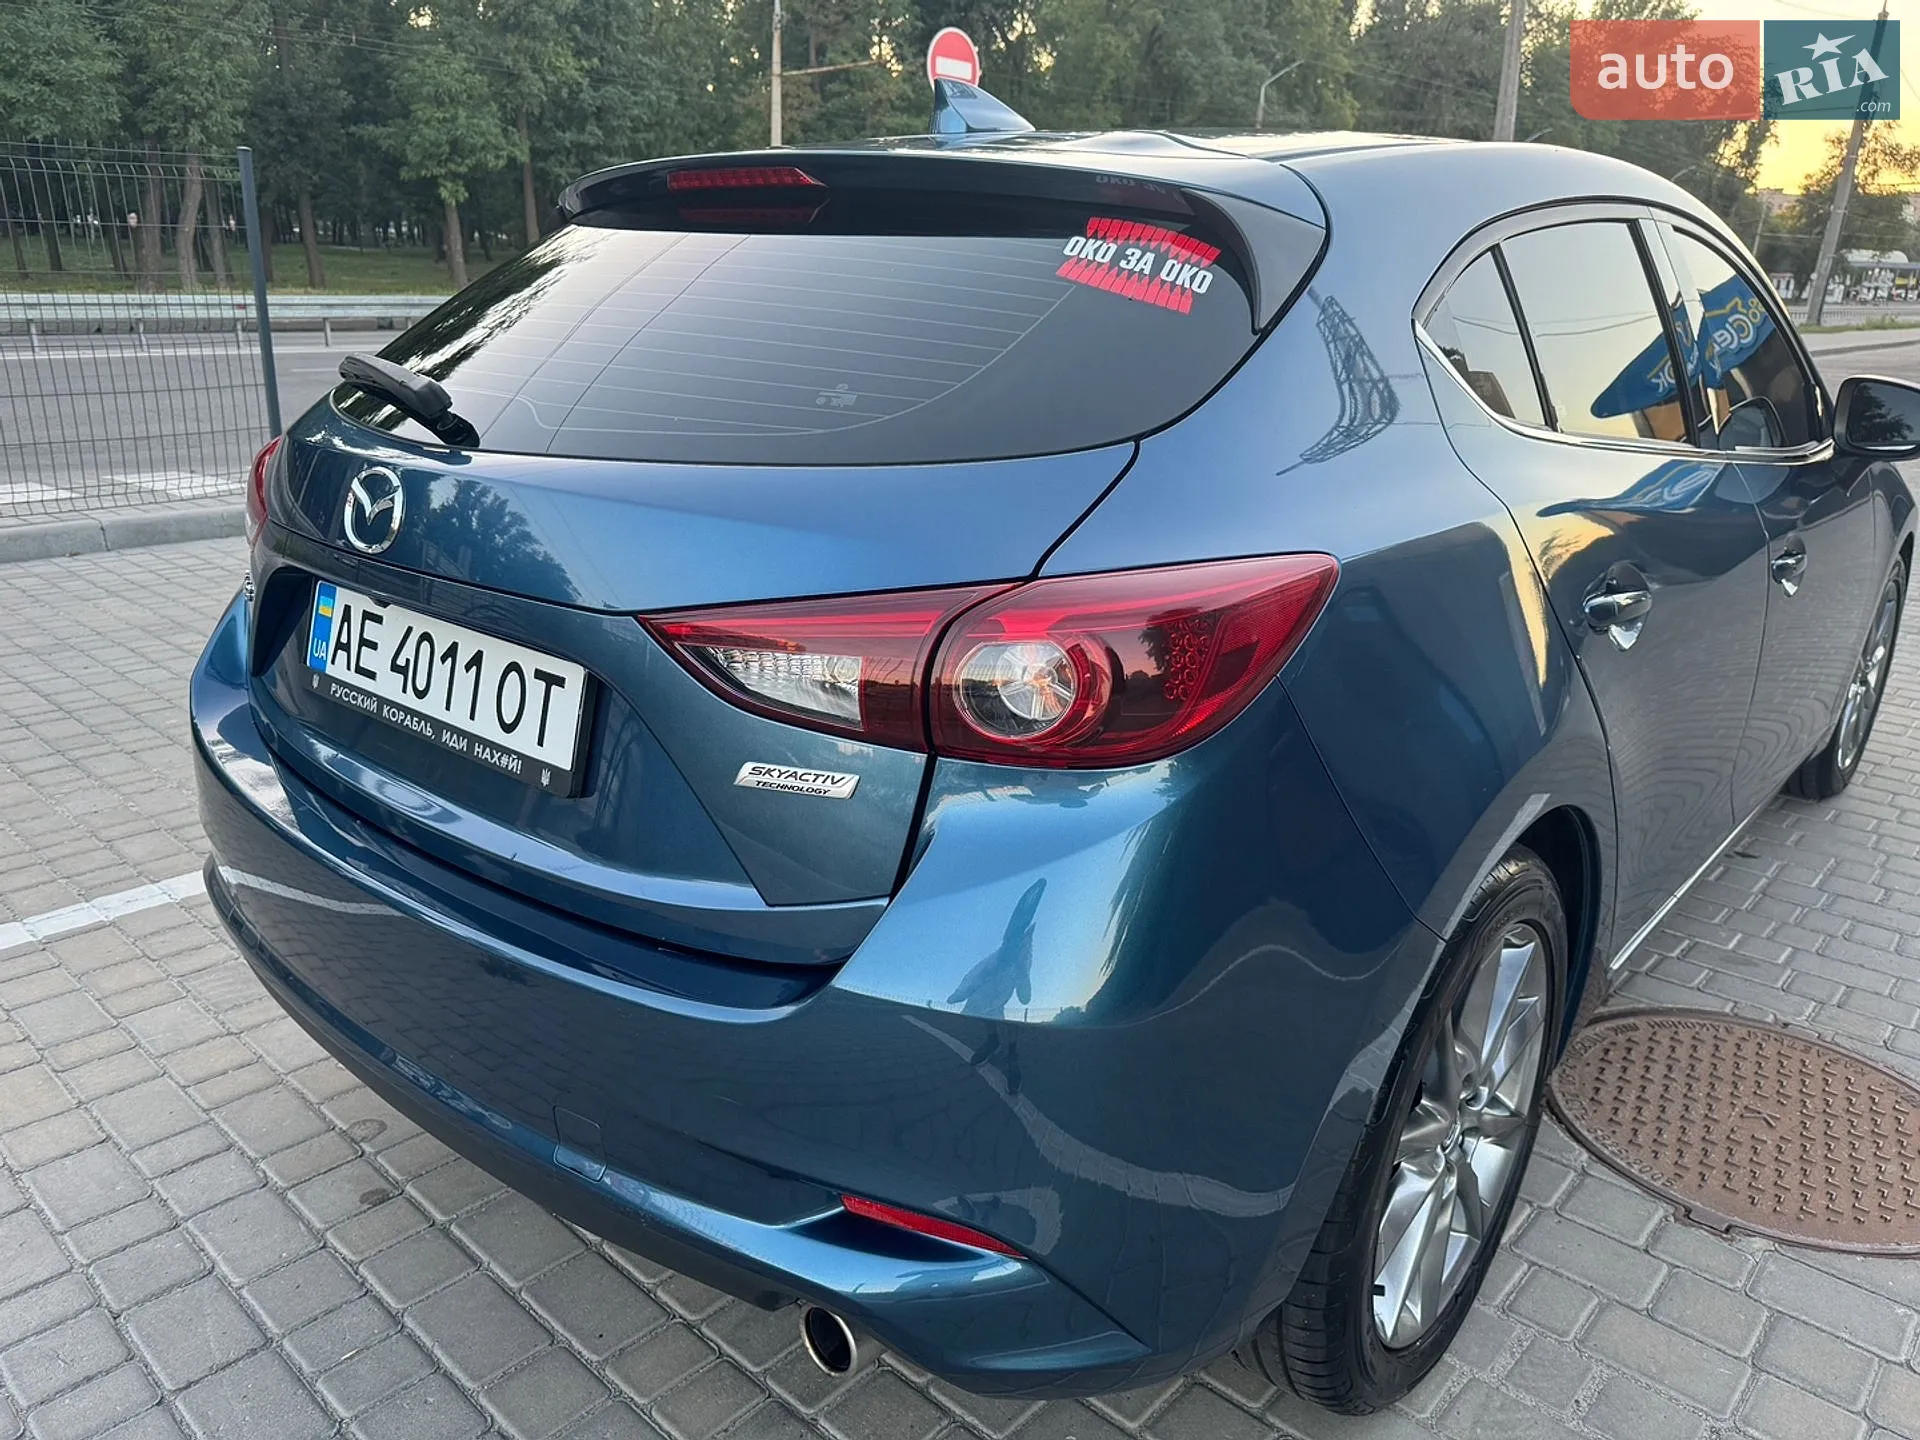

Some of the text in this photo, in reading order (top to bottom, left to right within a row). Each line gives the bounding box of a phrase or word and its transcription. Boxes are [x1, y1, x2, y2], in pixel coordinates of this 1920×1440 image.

[1062, 235, 1214, 294] ОКО ЗА ОКО
[313, 637, 327, 660] UA
[331, 603, 566, 748] AE 4011 OT
[330, 682, 523, 775] РУССКИЙ КОРАБЛЬ, ИДИ НАХ#Й!
[748, 766, 846, 785] SKYACTIV
[755, 780, 831, 795] TECHNOLOGY
